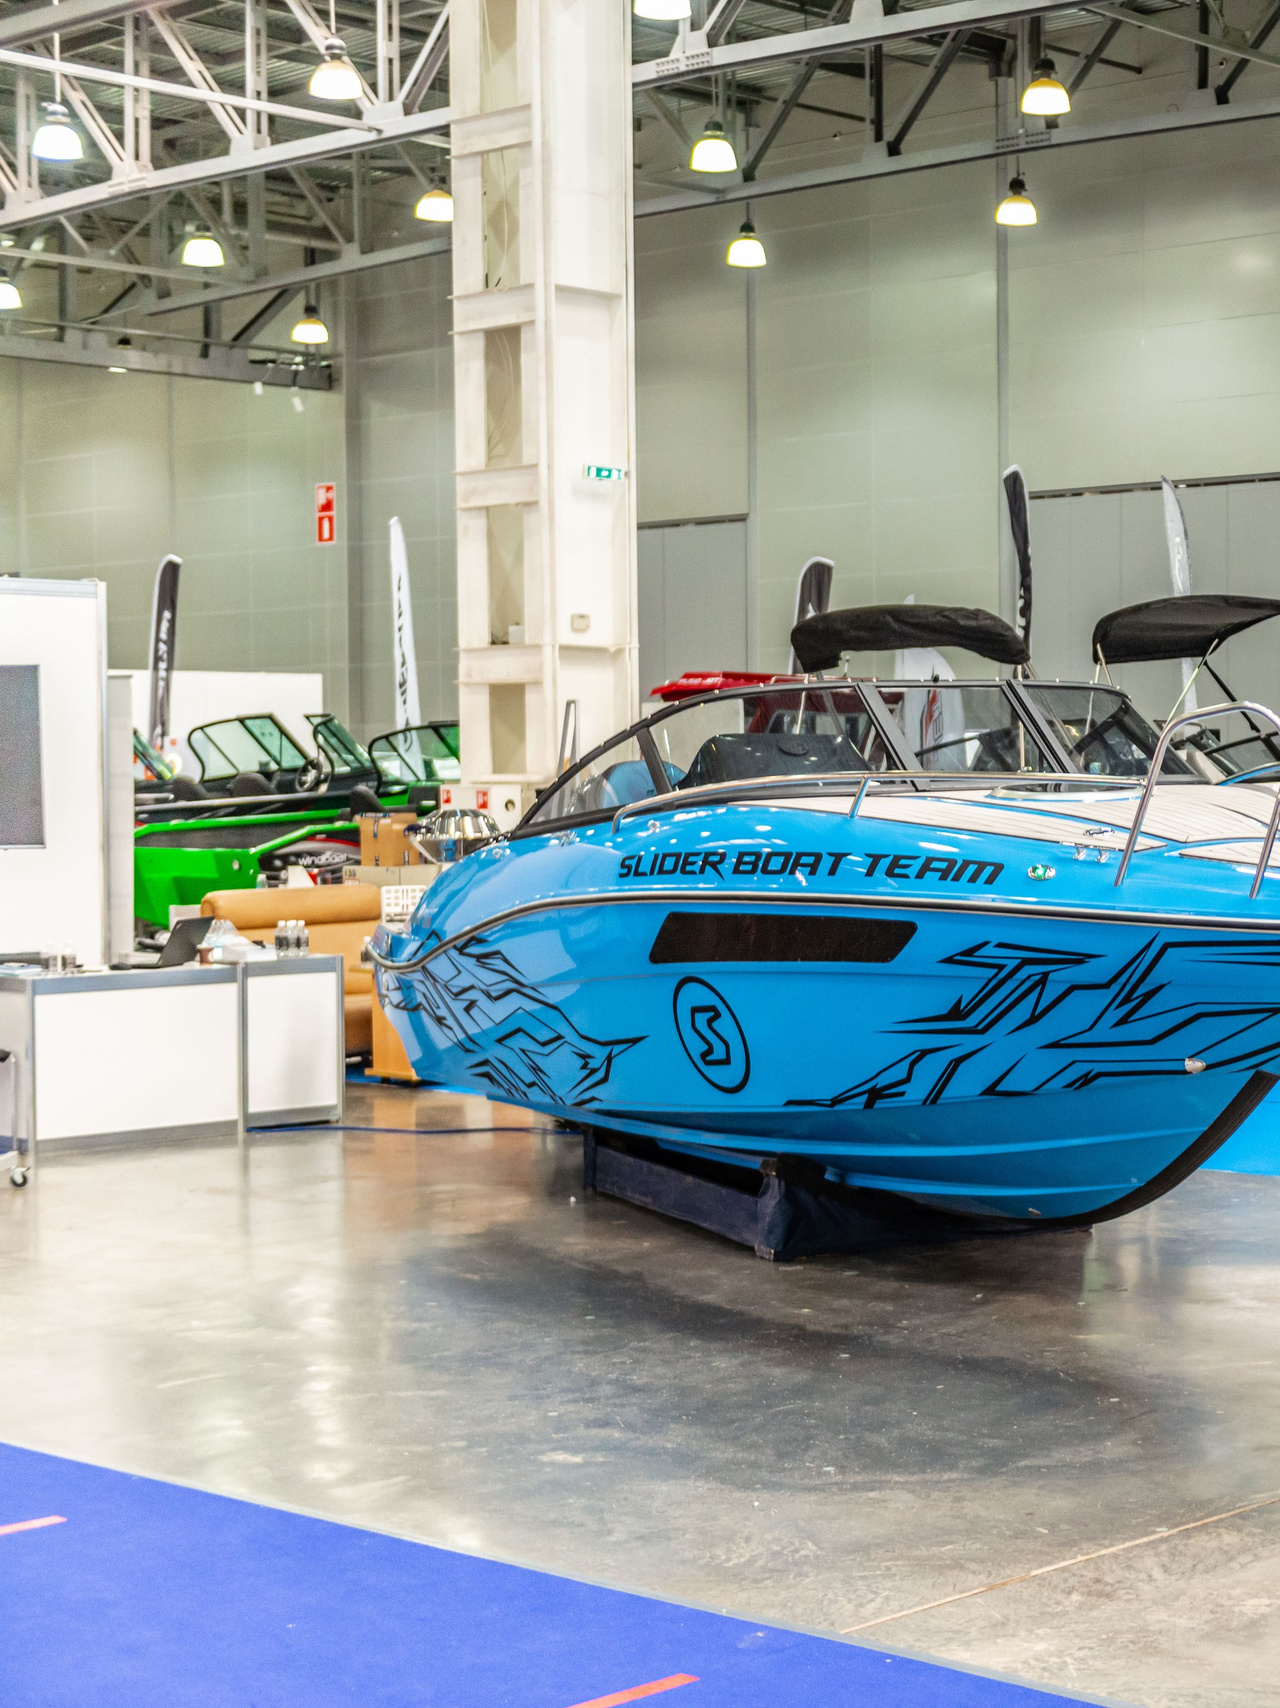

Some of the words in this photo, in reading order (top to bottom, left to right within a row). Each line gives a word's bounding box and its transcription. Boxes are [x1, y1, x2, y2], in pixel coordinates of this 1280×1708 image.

[298, 850, 349, 867] windboat
[618, 850, 726, 880] SLIDER
[732, 851, 853, 876] BOAT
[863, 853, 1005, 885] TEAM
